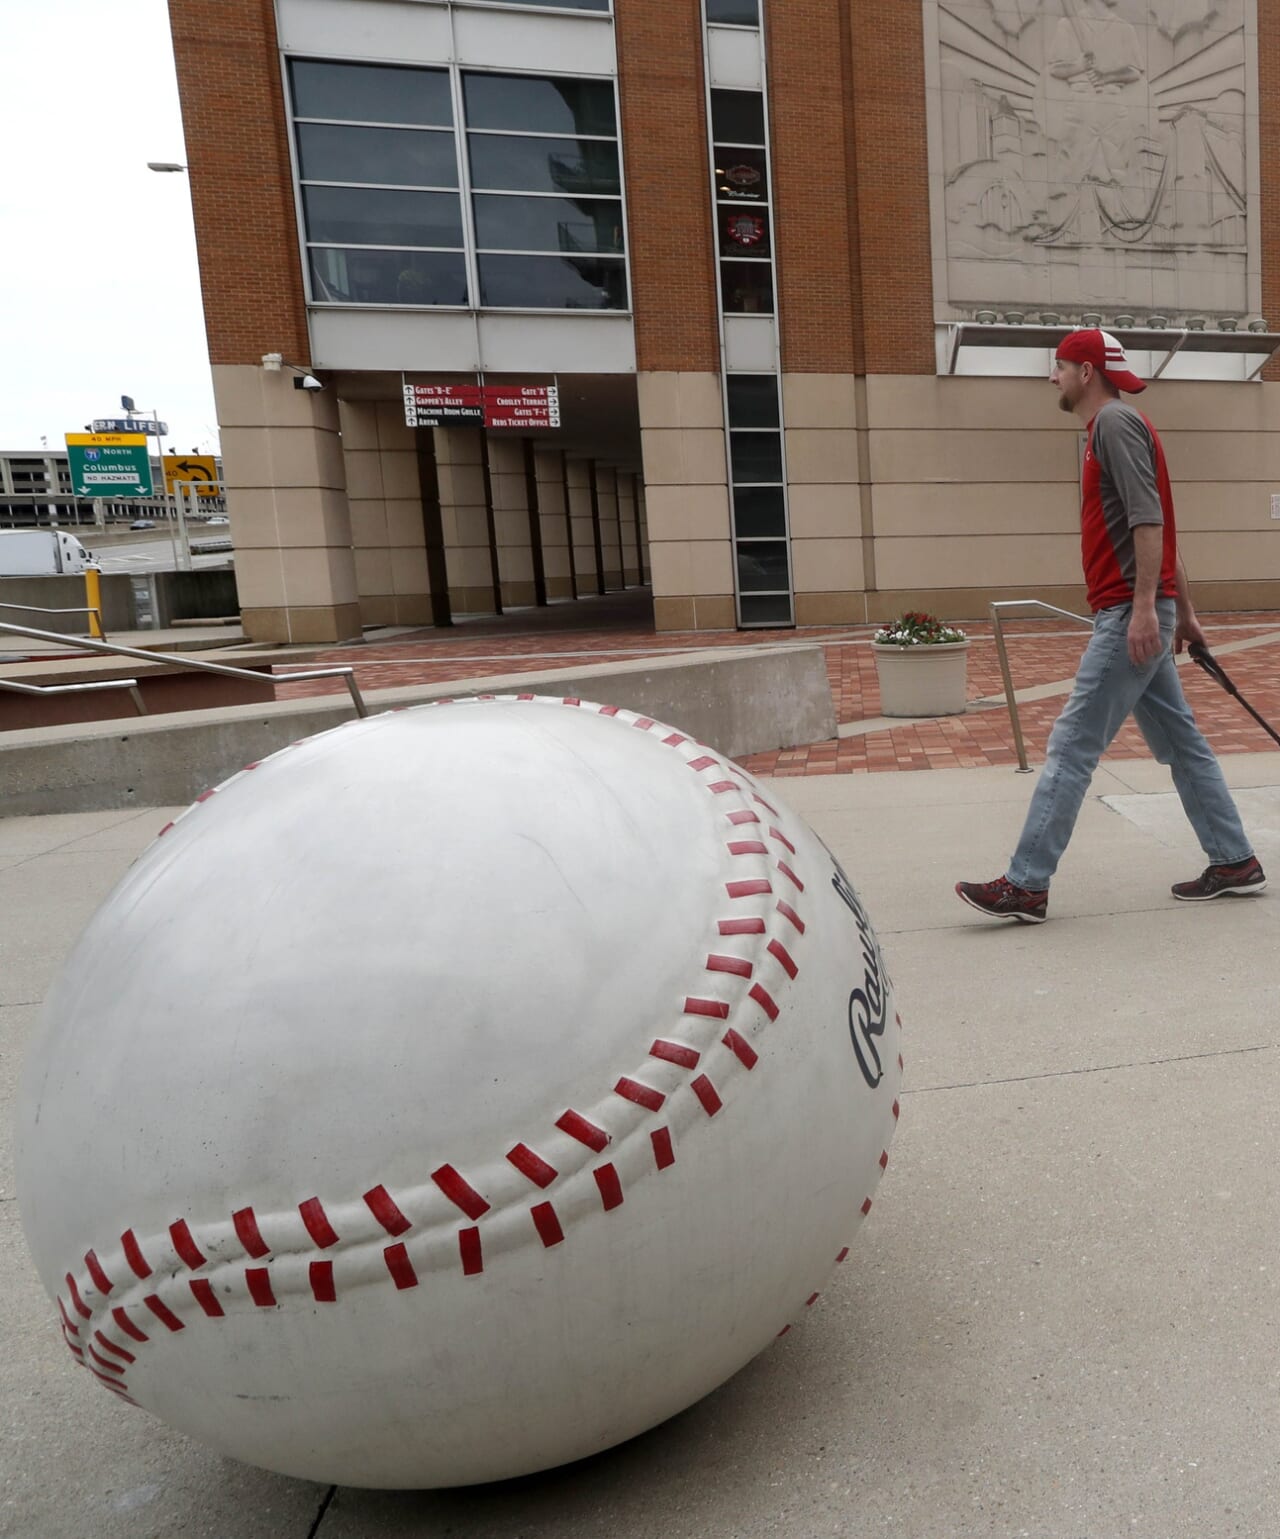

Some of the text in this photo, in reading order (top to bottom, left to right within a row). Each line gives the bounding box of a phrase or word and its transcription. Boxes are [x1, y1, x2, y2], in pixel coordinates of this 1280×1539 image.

[415, 386, 434, 394] GATES
[521, 387, 537, 396] GATE
[514, 408, 532, 416] GATES
[419, 418, 439, 426] ARENA
[507, 418, 528, 426] TICKET
[123, 421, 156, 432] LIFE
